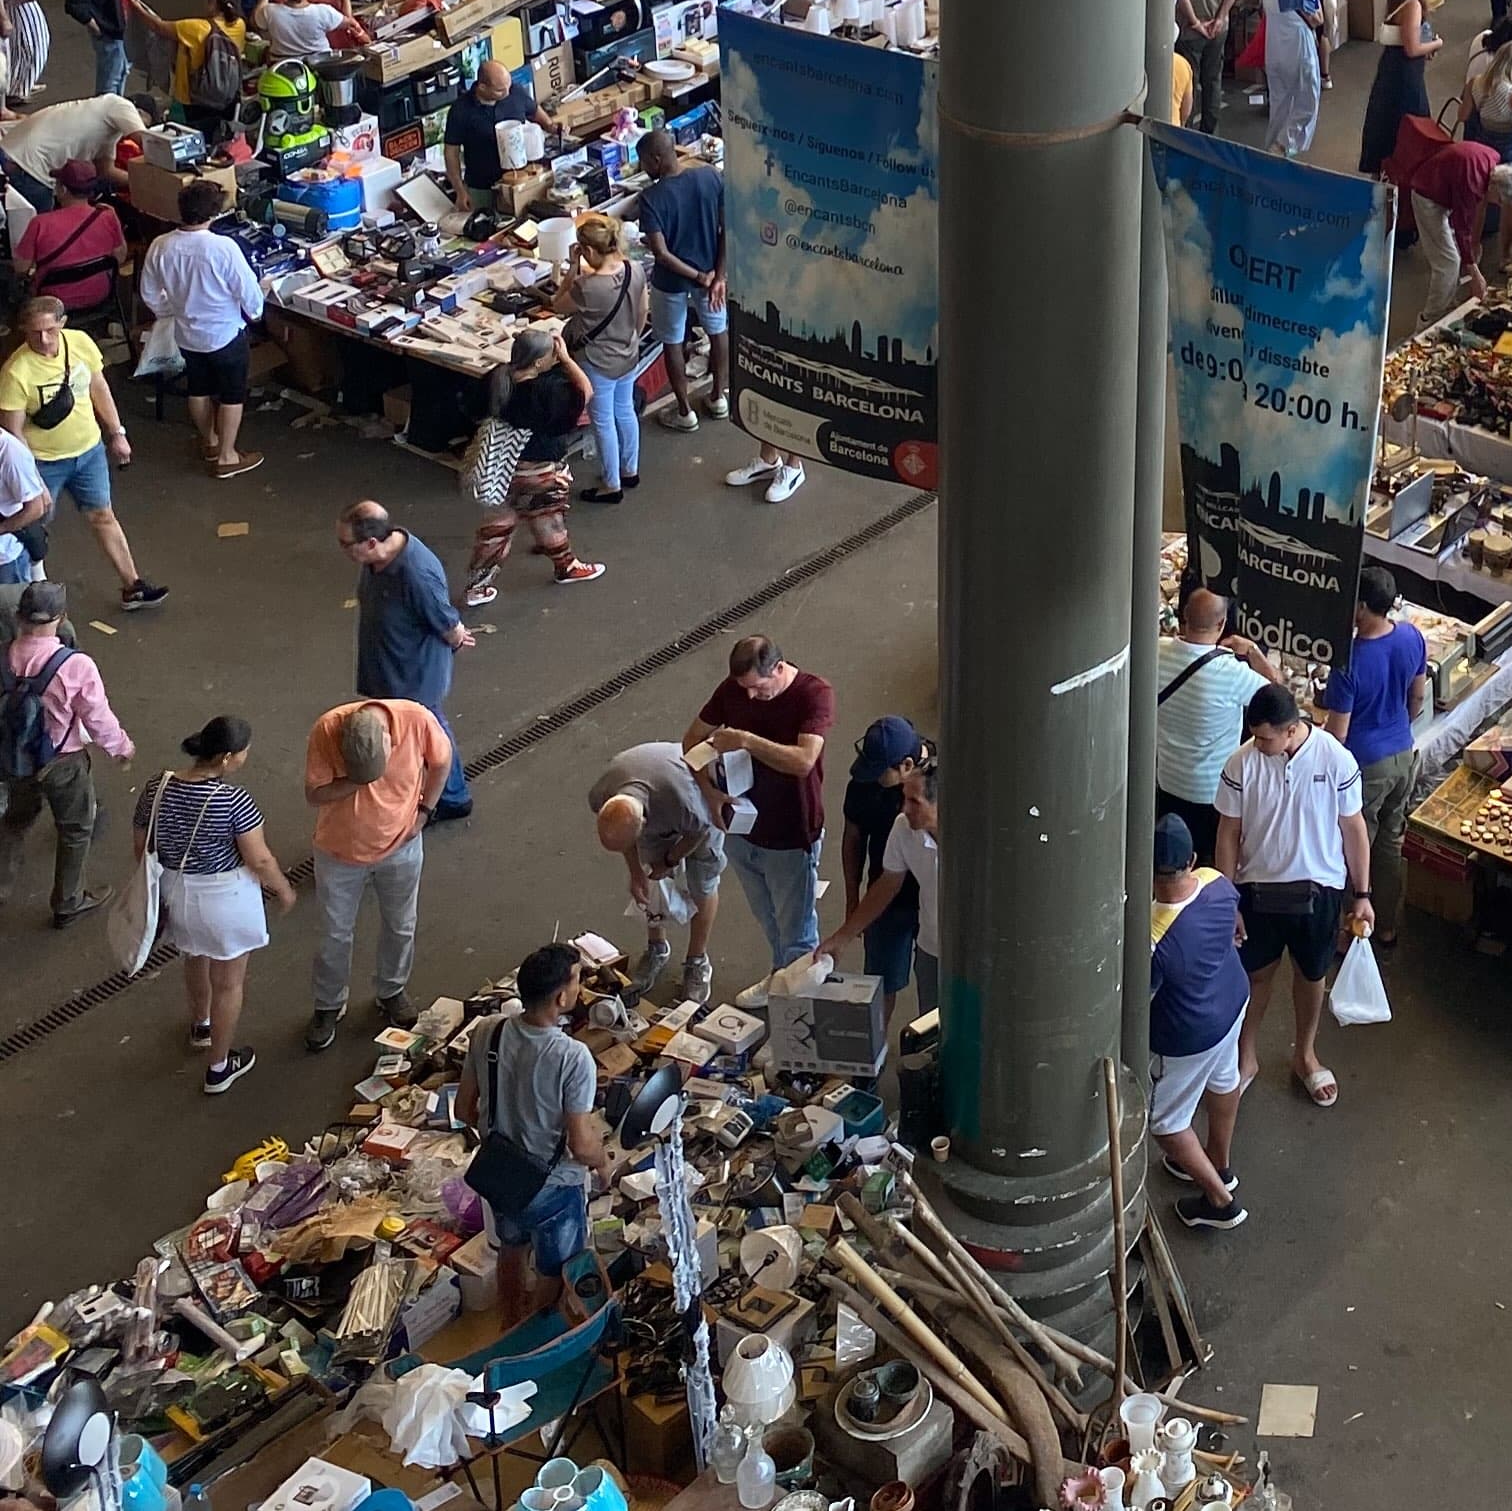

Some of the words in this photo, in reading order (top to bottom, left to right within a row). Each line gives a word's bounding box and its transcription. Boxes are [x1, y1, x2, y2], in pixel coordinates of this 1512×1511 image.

[784, 164, 908, 209] EncantsBarcelona
[784, 199, 877, 236] @encantsbcn
[785, 234, 905, 276] @encantsbarcelona
[1229, 244, 1302, 293] OERT
[1258, 346, 1330, 379] dissabte
[737, 354, 804, 395] ENCANTS
[812, 386, 925, 424] BARCELONA
[1254, 382, 1332, 425] 20:00
[829, 441, 889, 467] Barcelona
